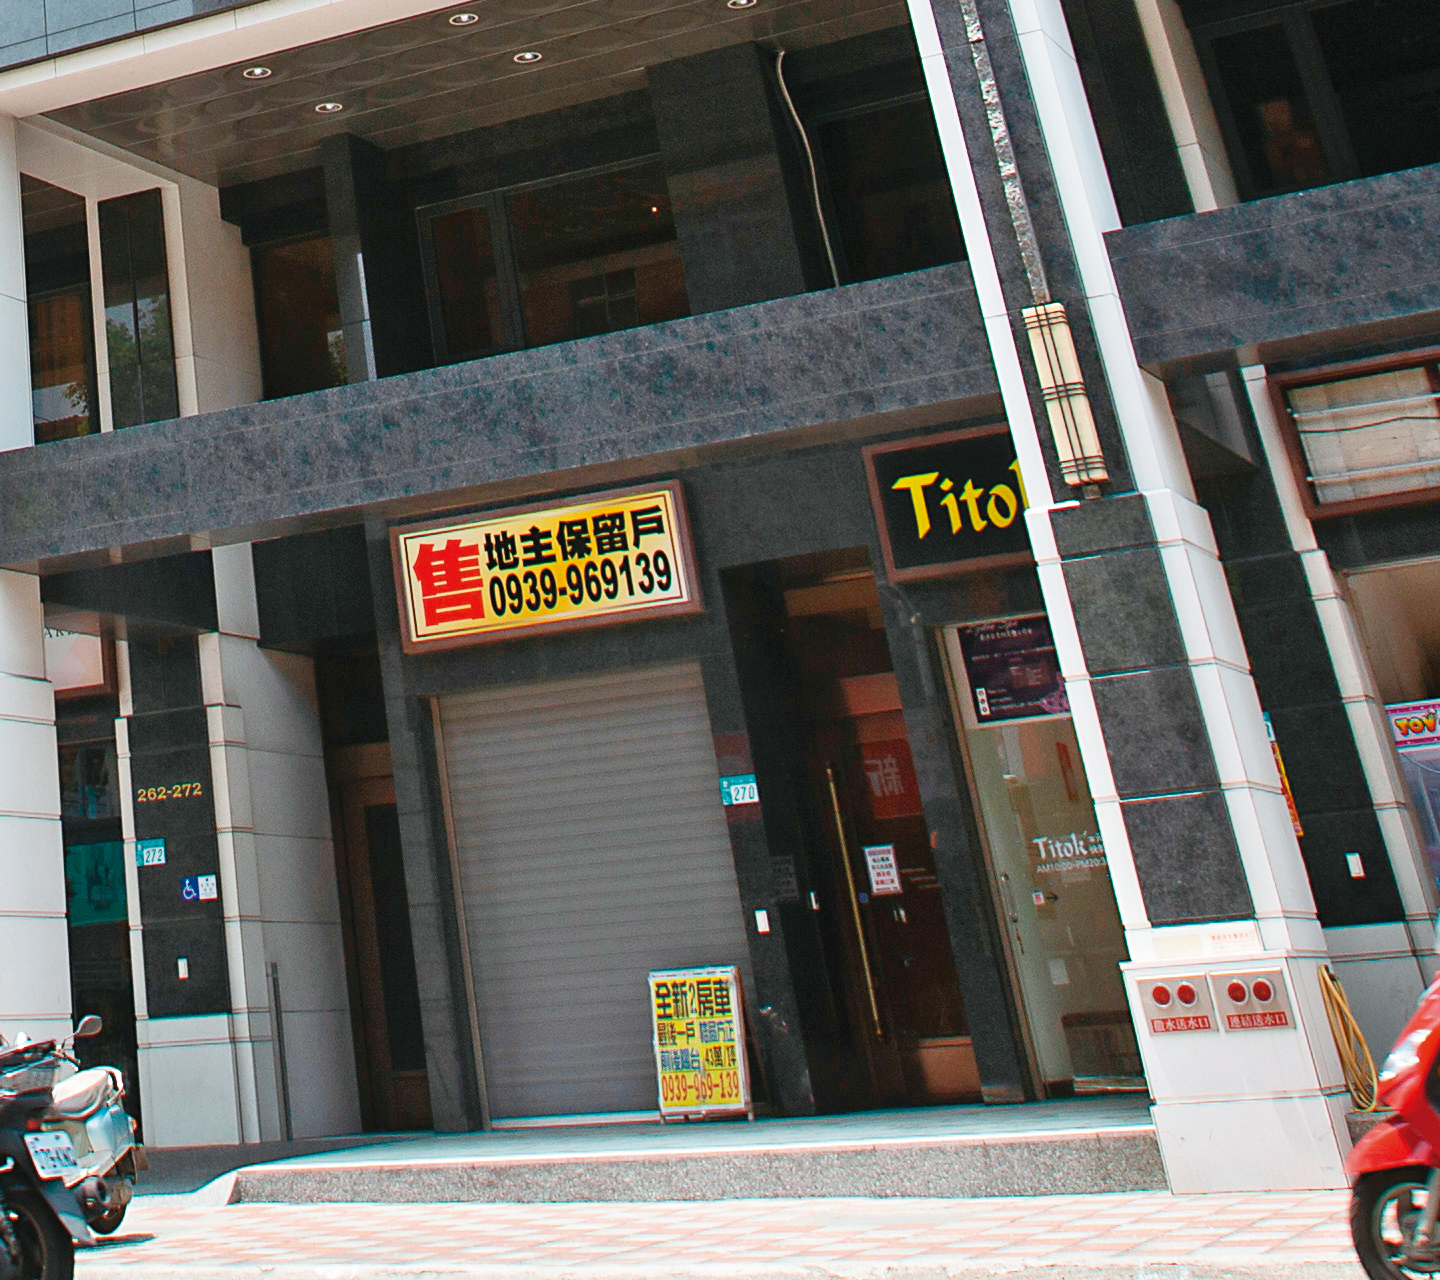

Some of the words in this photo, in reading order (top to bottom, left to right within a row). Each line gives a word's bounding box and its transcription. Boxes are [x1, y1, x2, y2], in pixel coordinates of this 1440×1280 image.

[483, 505, 666, 572] 地主保留戶
[412, 538, 486, 627] 售
[489, 549, 673, 617] 0939-969139
[1394, 714, 1438, 737] TOY
[137, 782, 203, 803] 262-272
[733, 786, 756, 802] 270
[145, 847, 164, 864] 272
[1032, 832, 1089, 860] Titok
[661, 1070, 740, 1102] 0939-969-139
